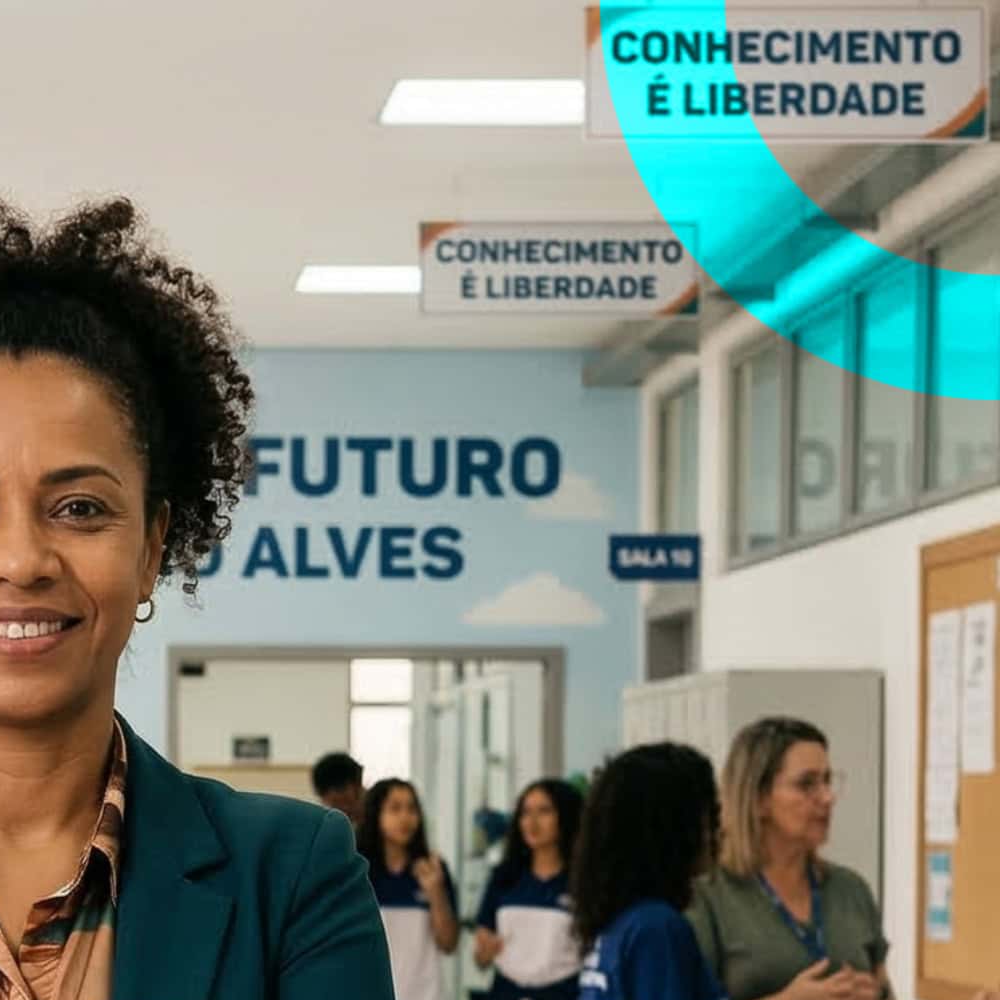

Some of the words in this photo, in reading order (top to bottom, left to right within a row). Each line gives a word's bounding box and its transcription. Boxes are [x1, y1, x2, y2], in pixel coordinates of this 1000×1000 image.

[612, 27, 963, 67] CONHECIMENTO
[647, 74, 670, 117] É
[684, 81, 926, 118] LIBERDADE
[435, 238, 683, 265] CONHECIMENTO
[486, 275, 657, 300] LIBERDADE
[246, 435, 562, 498] FUTURO
[242, 525, 465, 580] ALVES
